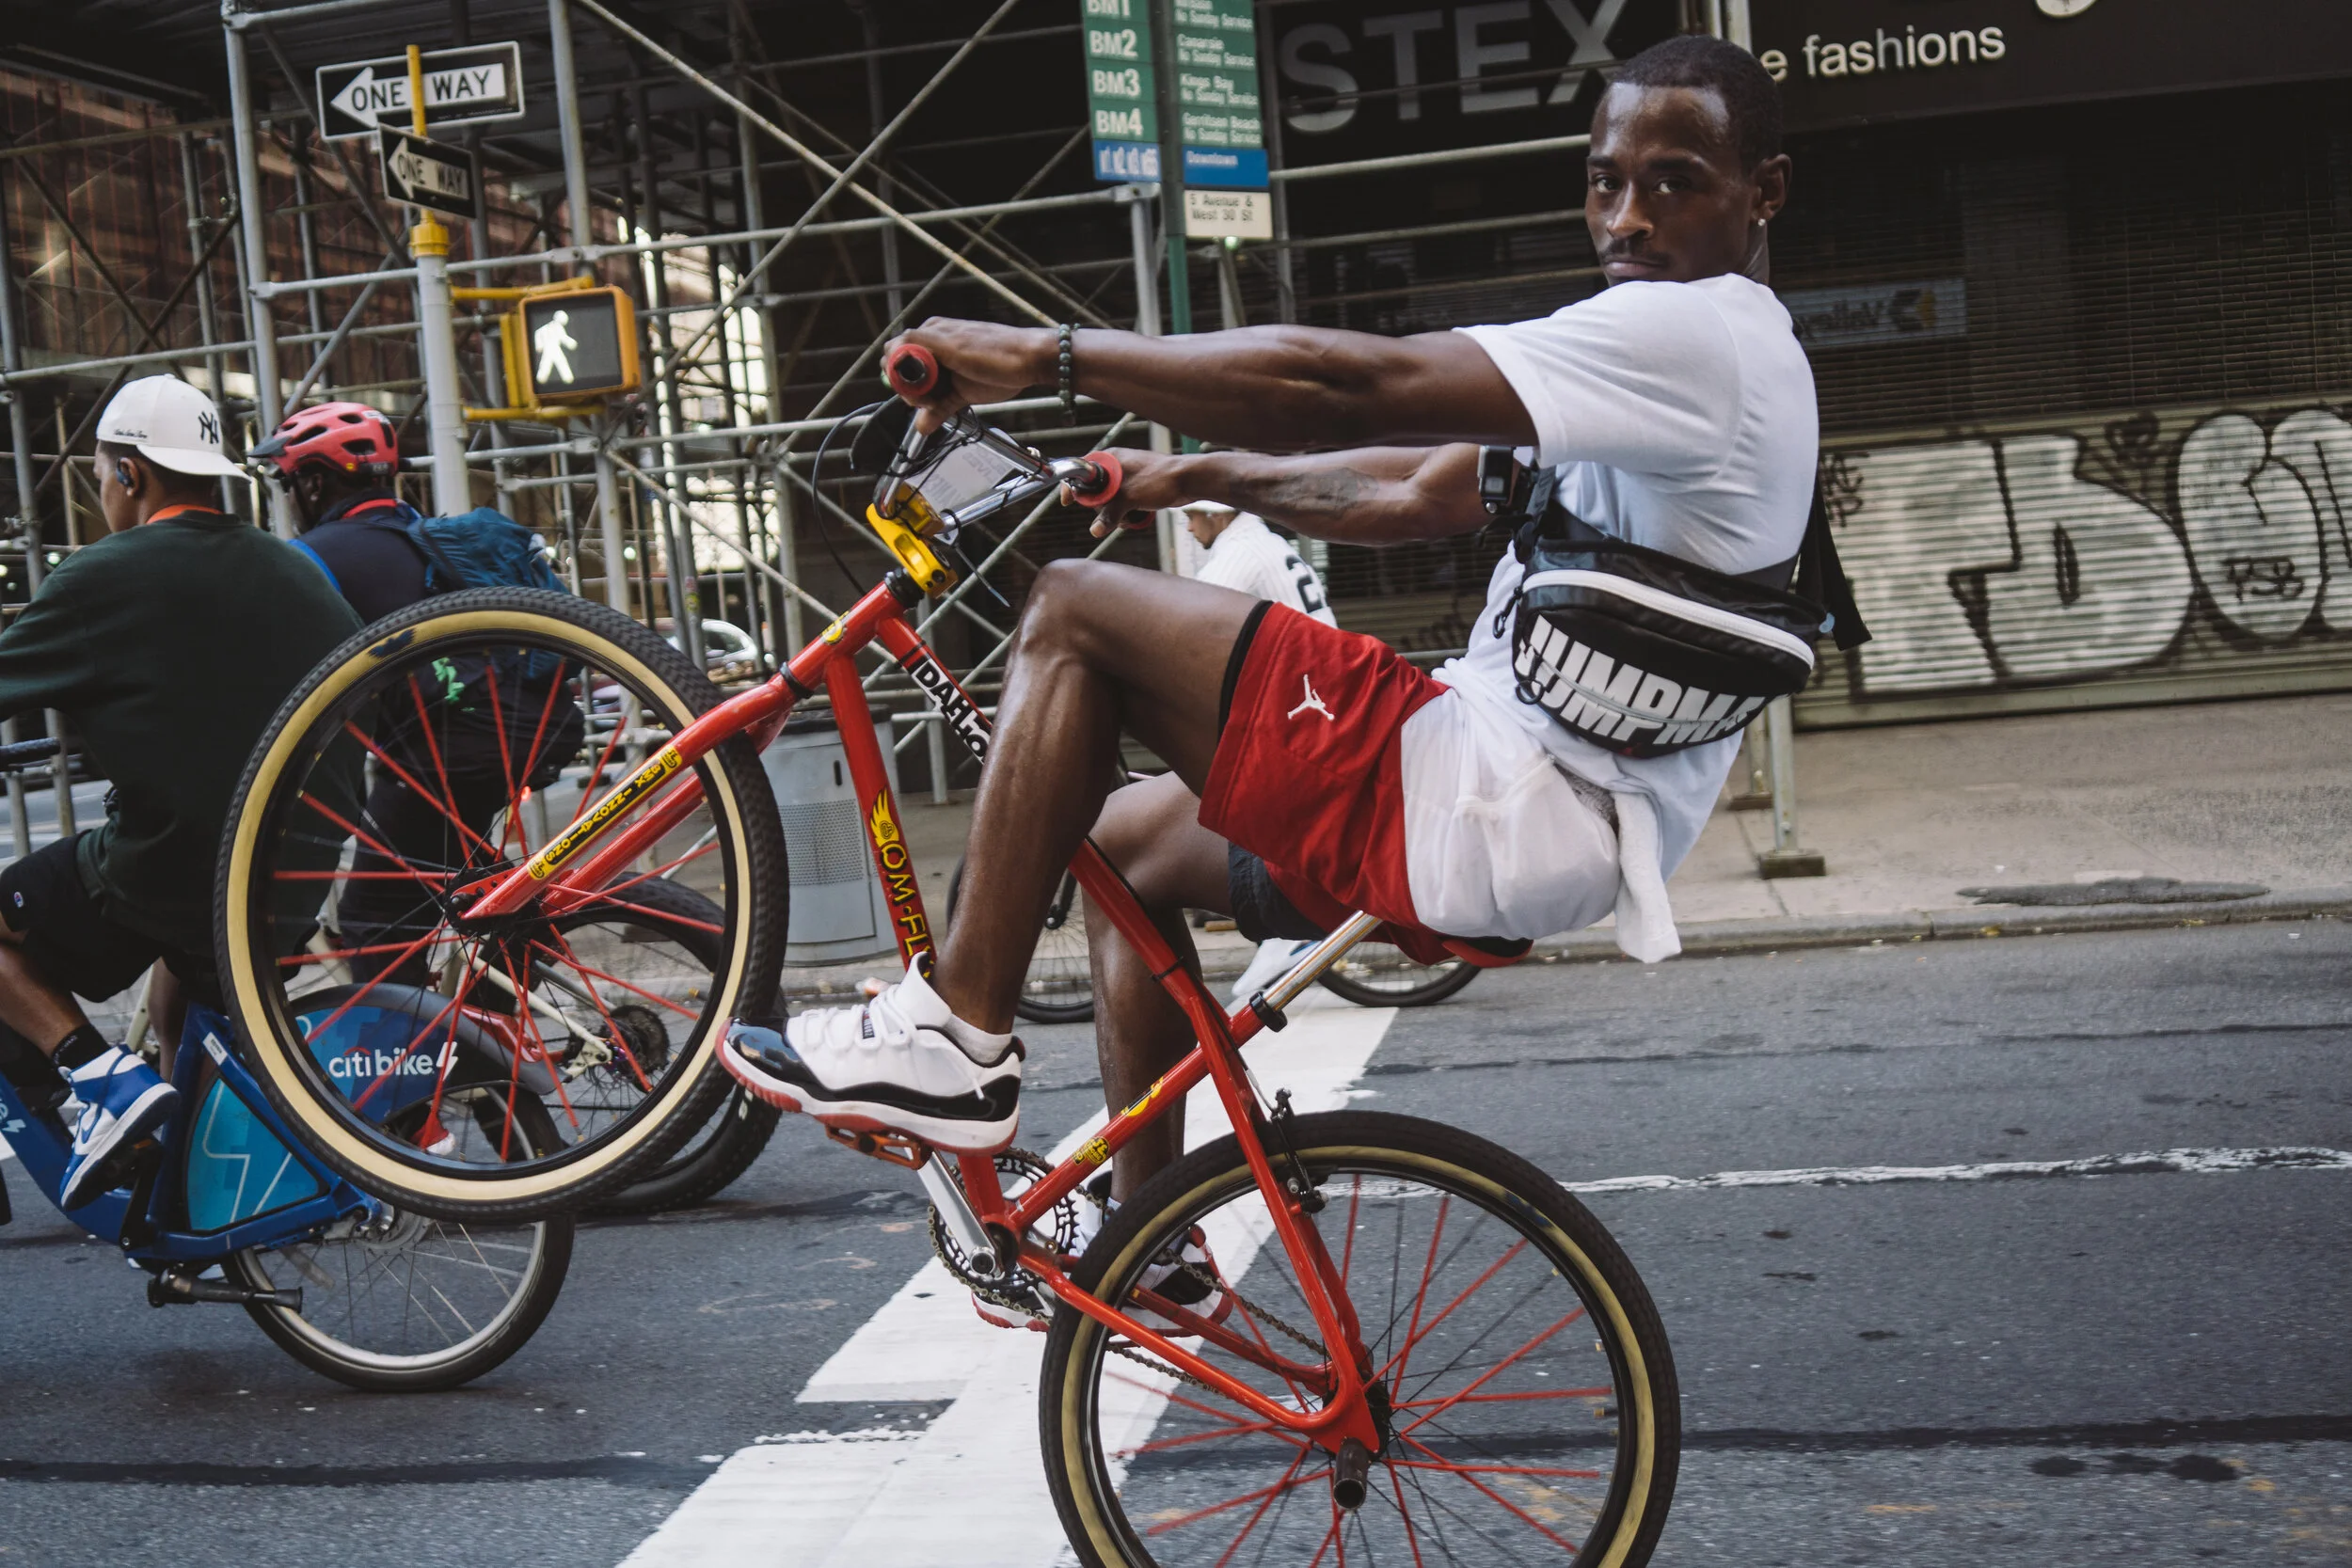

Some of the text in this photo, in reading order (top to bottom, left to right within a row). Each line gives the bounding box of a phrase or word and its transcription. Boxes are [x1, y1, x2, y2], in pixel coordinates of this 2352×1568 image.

[1087, 0, 1130, 16] BM1
[1089, 28, 1138, 56] BM2
[1760, 25, 2006, 83] e fashions
[351, 69, 490, 111] ONE WAY
[1092, 69, 1141, 97] BM3
[1095, 107, 1144, 136] BM4
[397, 153, 464, 194] ONE WAY
[198, 410, 219, 444] NY
[1515, 613, 1767, 745] JUMPMA
[915, 661, 992, 761] DAHO
[546, 763, 663, 862] BMX INNOVATIONS
